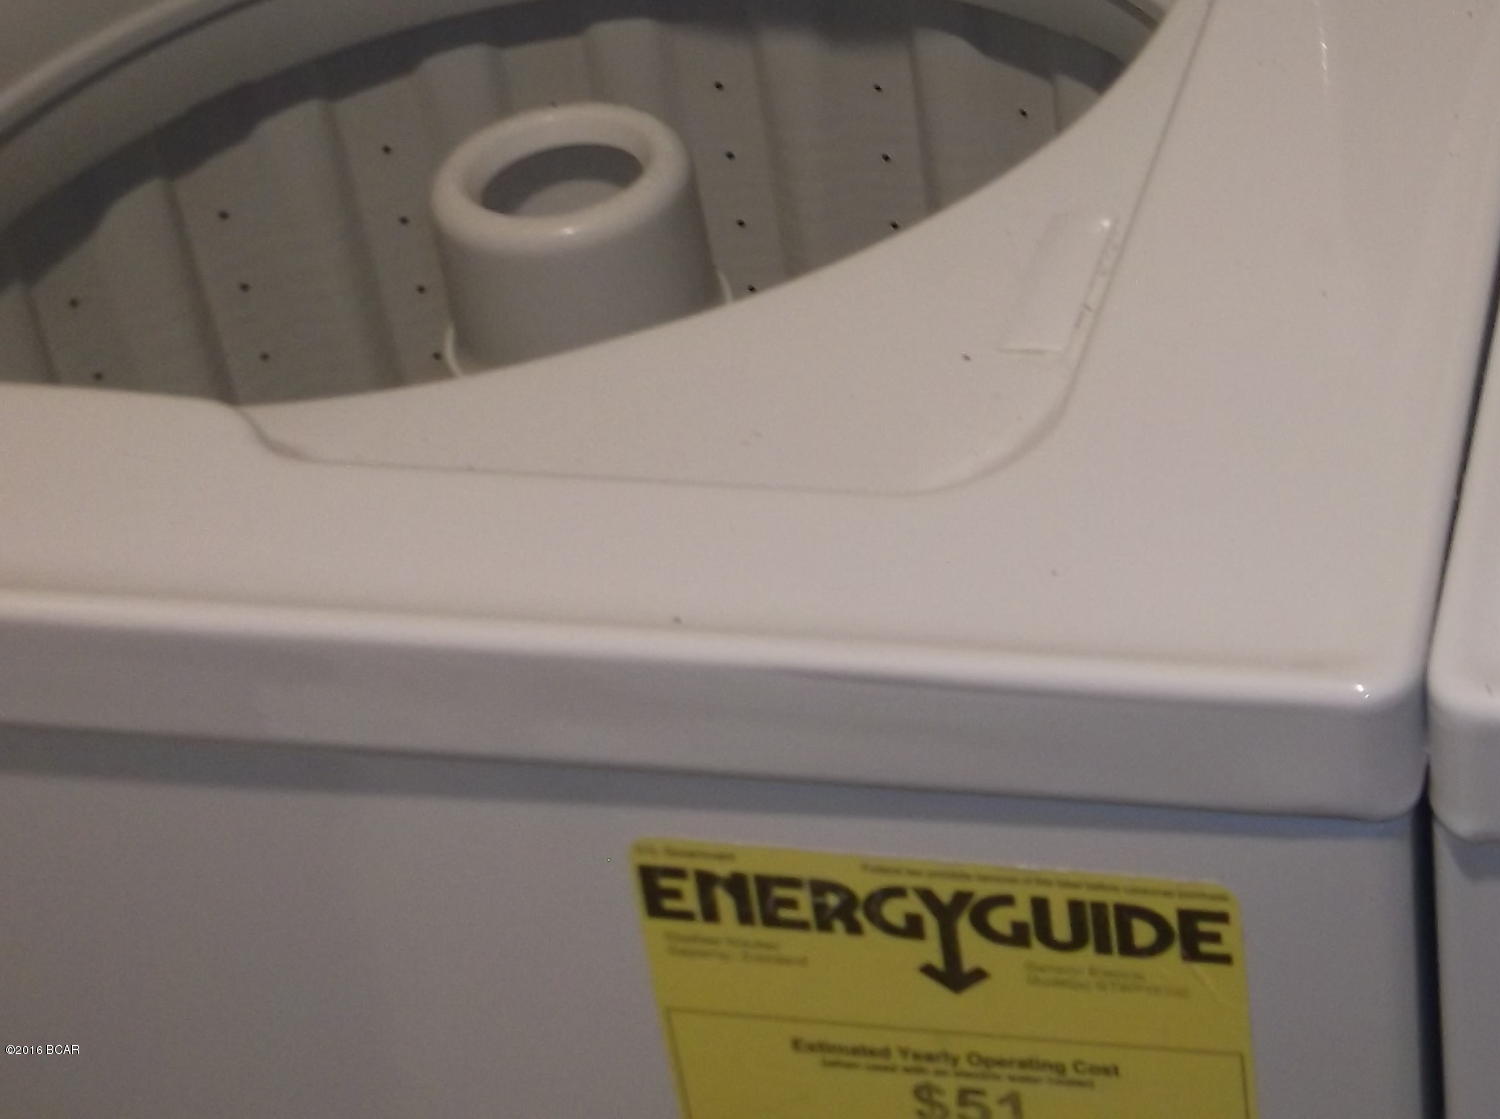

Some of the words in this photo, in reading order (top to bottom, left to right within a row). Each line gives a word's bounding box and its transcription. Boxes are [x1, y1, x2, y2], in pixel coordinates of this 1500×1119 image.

[789, 1034, 893, 1060] Estimated
[895, 1044, 961, 1069] Yearly
[964, 1049, 1068, 1078] Operating
[1071, 1056, 1123, 1079] Cost
